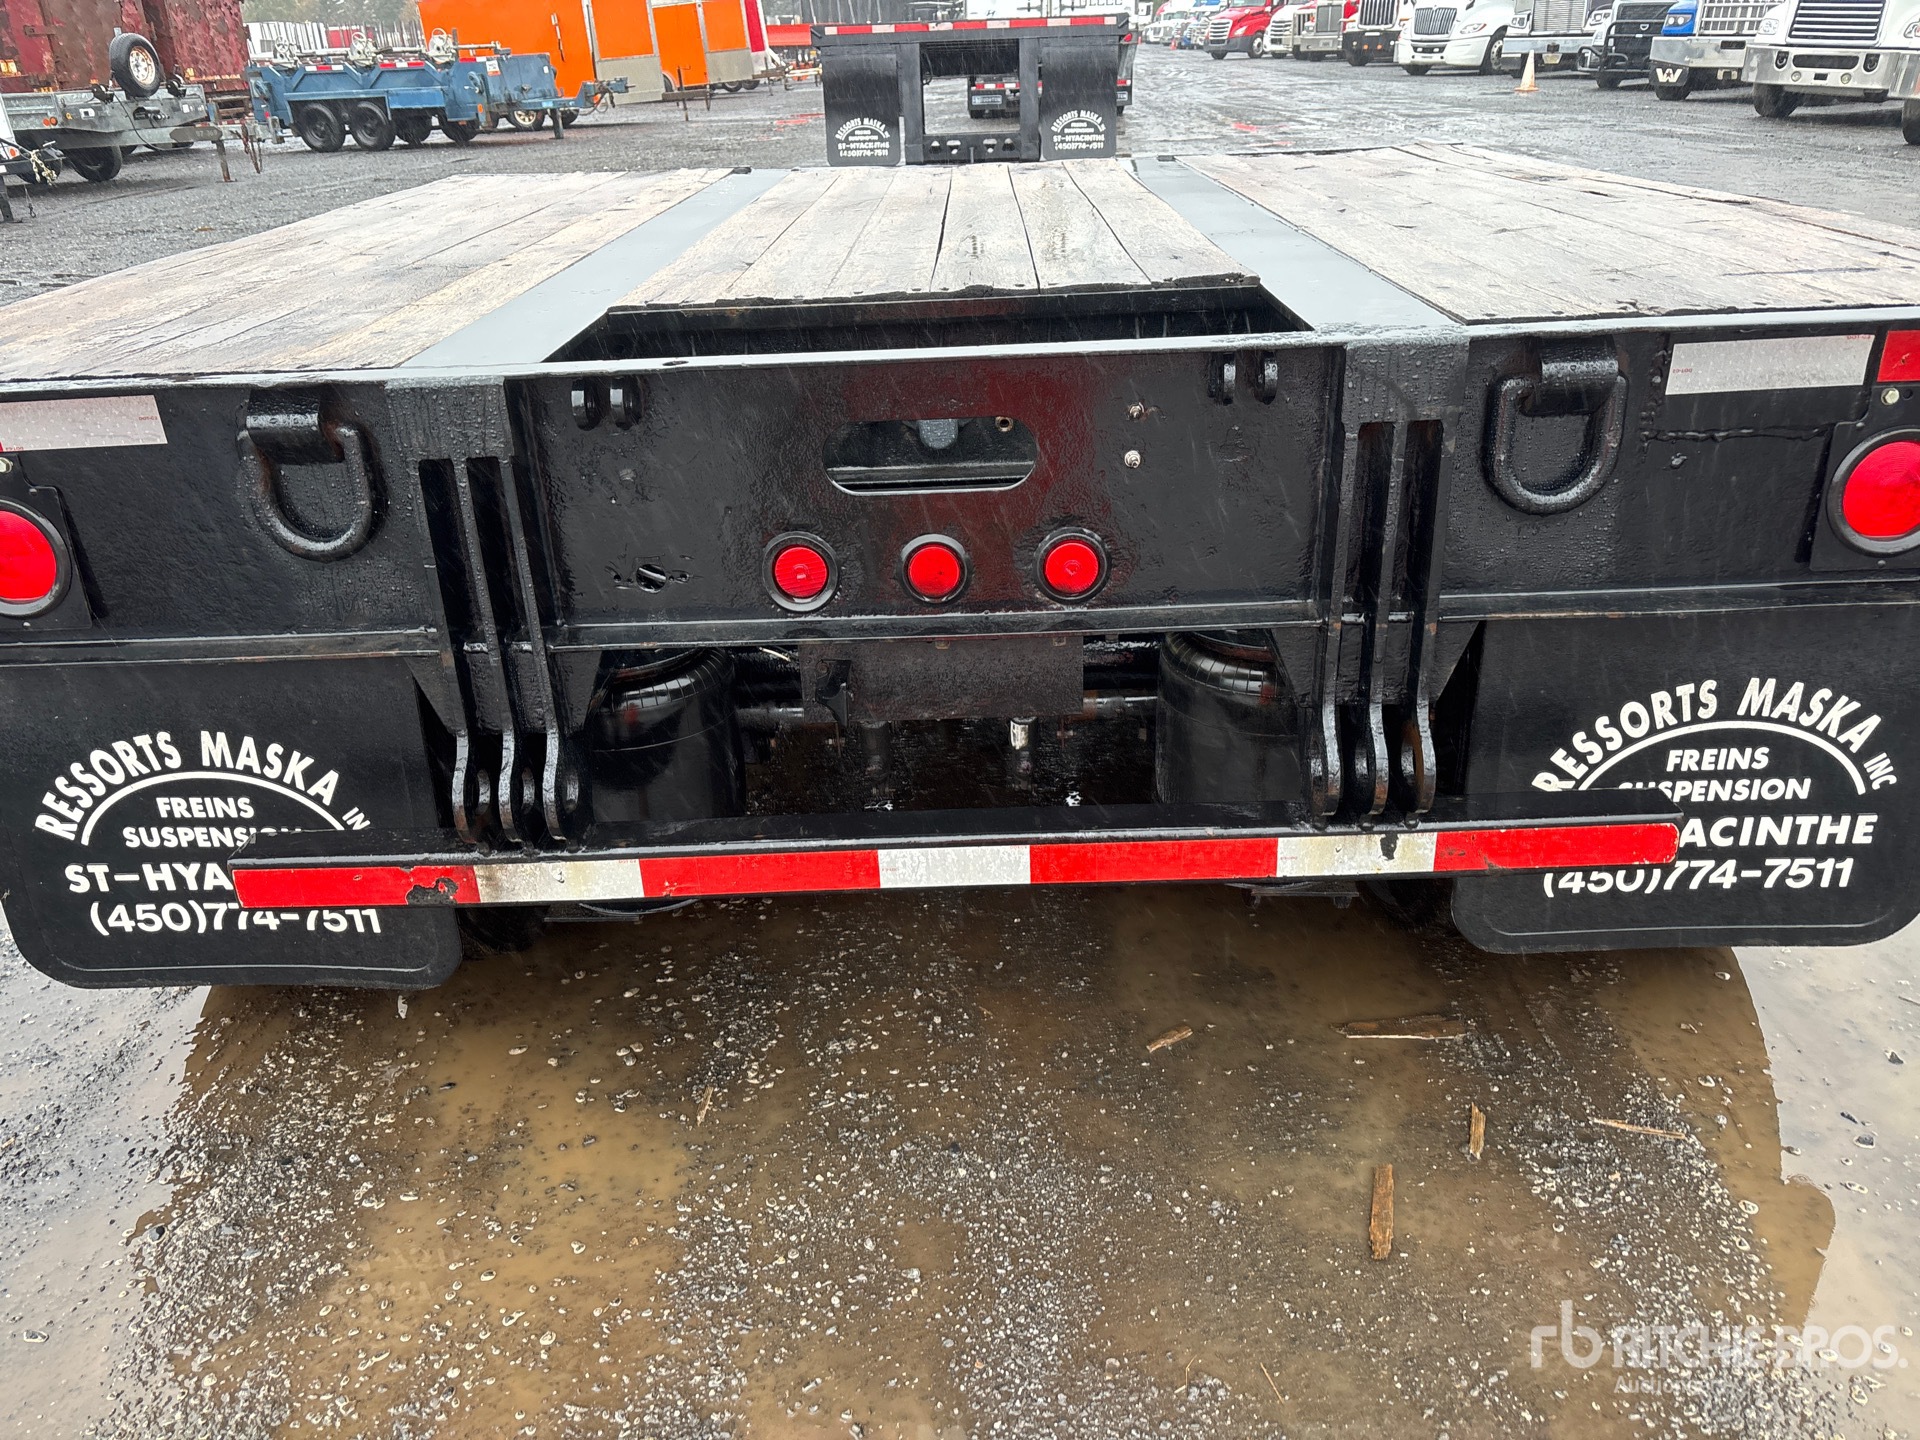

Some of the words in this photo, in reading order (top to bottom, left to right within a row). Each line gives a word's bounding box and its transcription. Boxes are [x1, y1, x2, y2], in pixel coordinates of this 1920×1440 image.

[1531, 679, 1718, 792] RESSORTS
[1736, 677, 1882, 754] MASKA
[1862, 752, 1898, 791] INC
[1665, 747, 1770, 772] FREINS
[35, 731, 182, 841] RESSORTS
[201, 731, 340, 806] MASKA
[342, 807, 370, 830] IN
[1618, 778, 1812, 803] SPENSION
[156, 797, 255, 819] FREINS
[123, 826, 302, 848] SUSPENS
[1679, 814, 1878, 848] ACINTHE
[64, 863, 234, 893] ST-HYA
[1543, 858, 1854, 898] (450)774-7511
[90, 901, 382, 935] (450)774-7511
